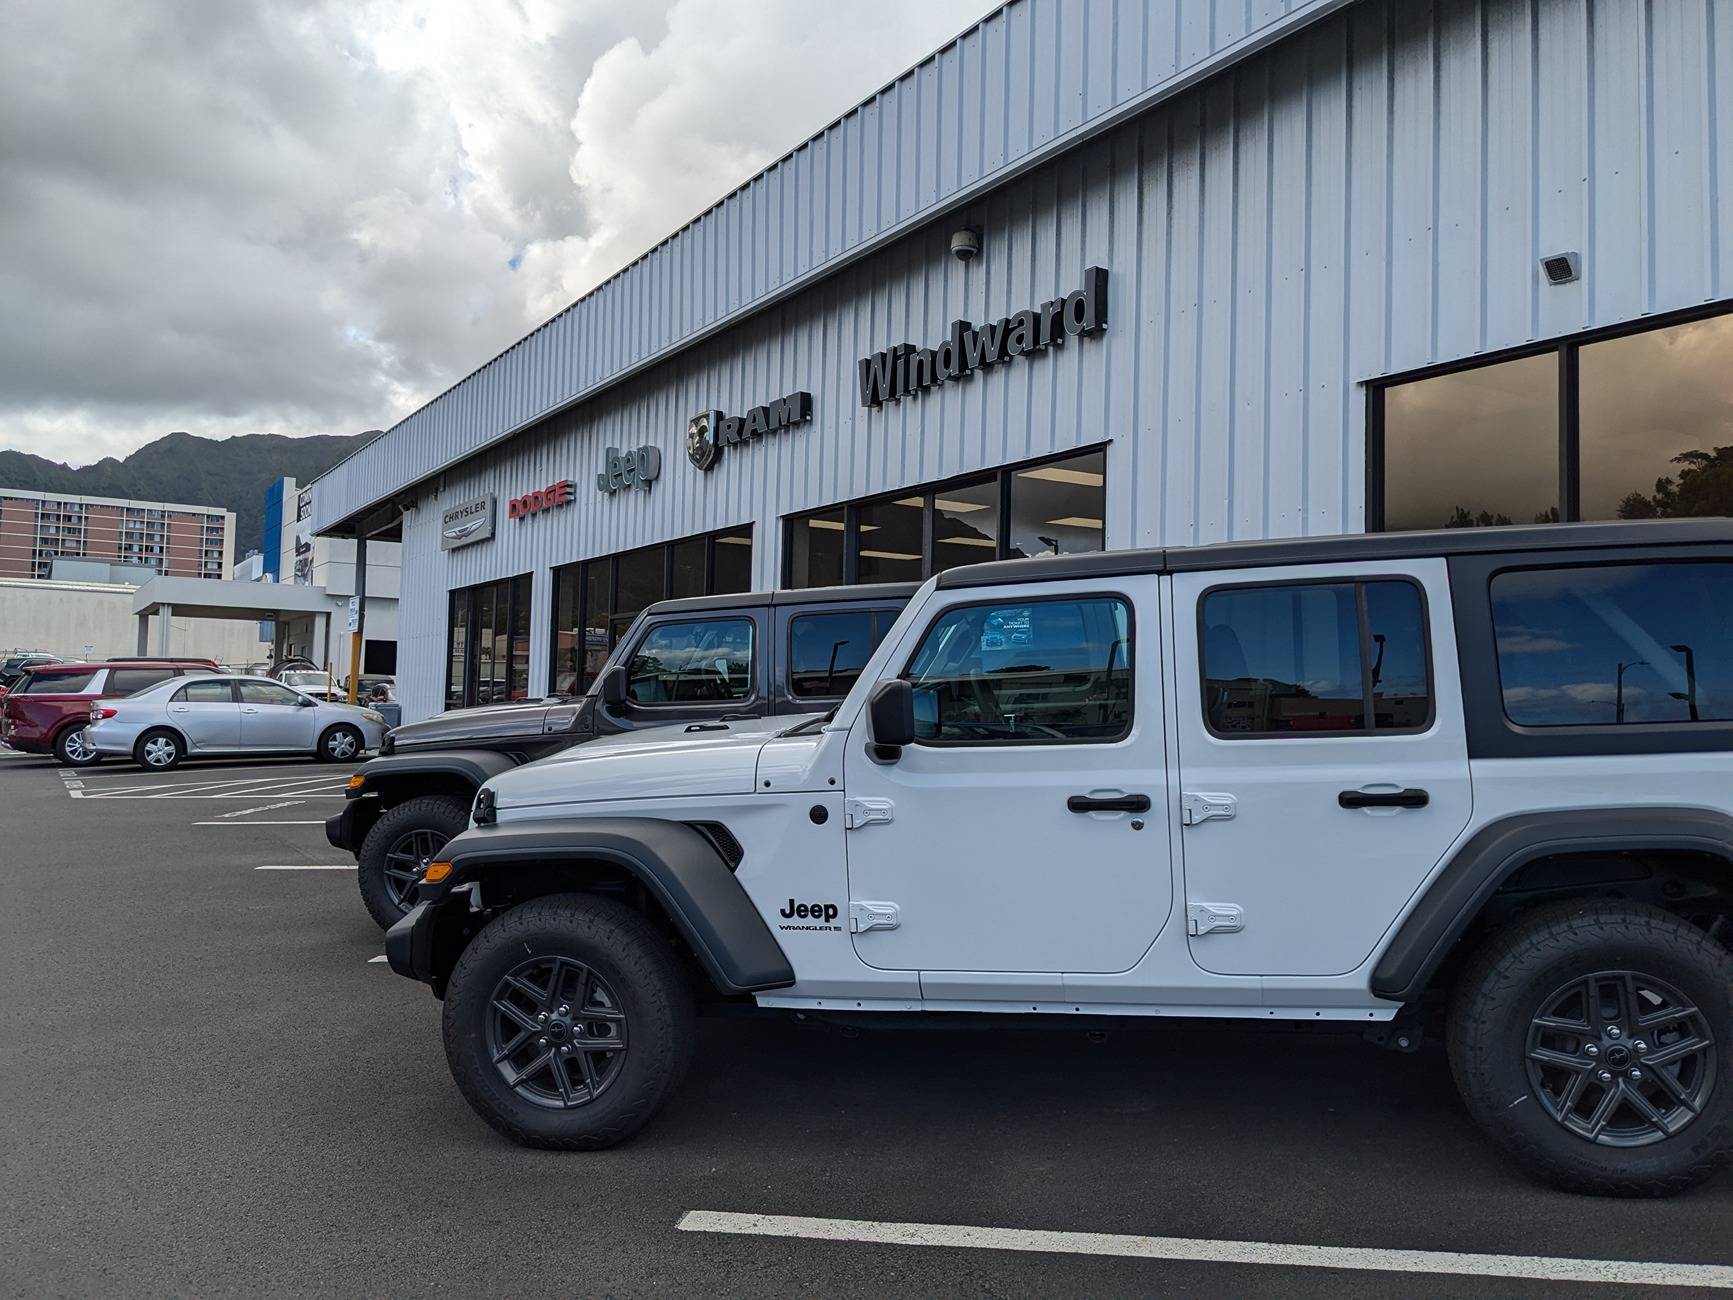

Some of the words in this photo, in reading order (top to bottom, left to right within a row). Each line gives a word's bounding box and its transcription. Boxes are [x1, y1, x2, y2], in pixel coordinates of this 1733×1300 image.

[858, 266, 1109, 408] Windward
[718, 390, 812, 448] RAM
[597, 445, 661, 493] Jeep
[443, 500, 487, 525] CHRYSLER
[508, 479, 577, 519] DODGE
[778, 924, 832, 932] WRANGLER
[780, 898, 839, 923] Jeep
